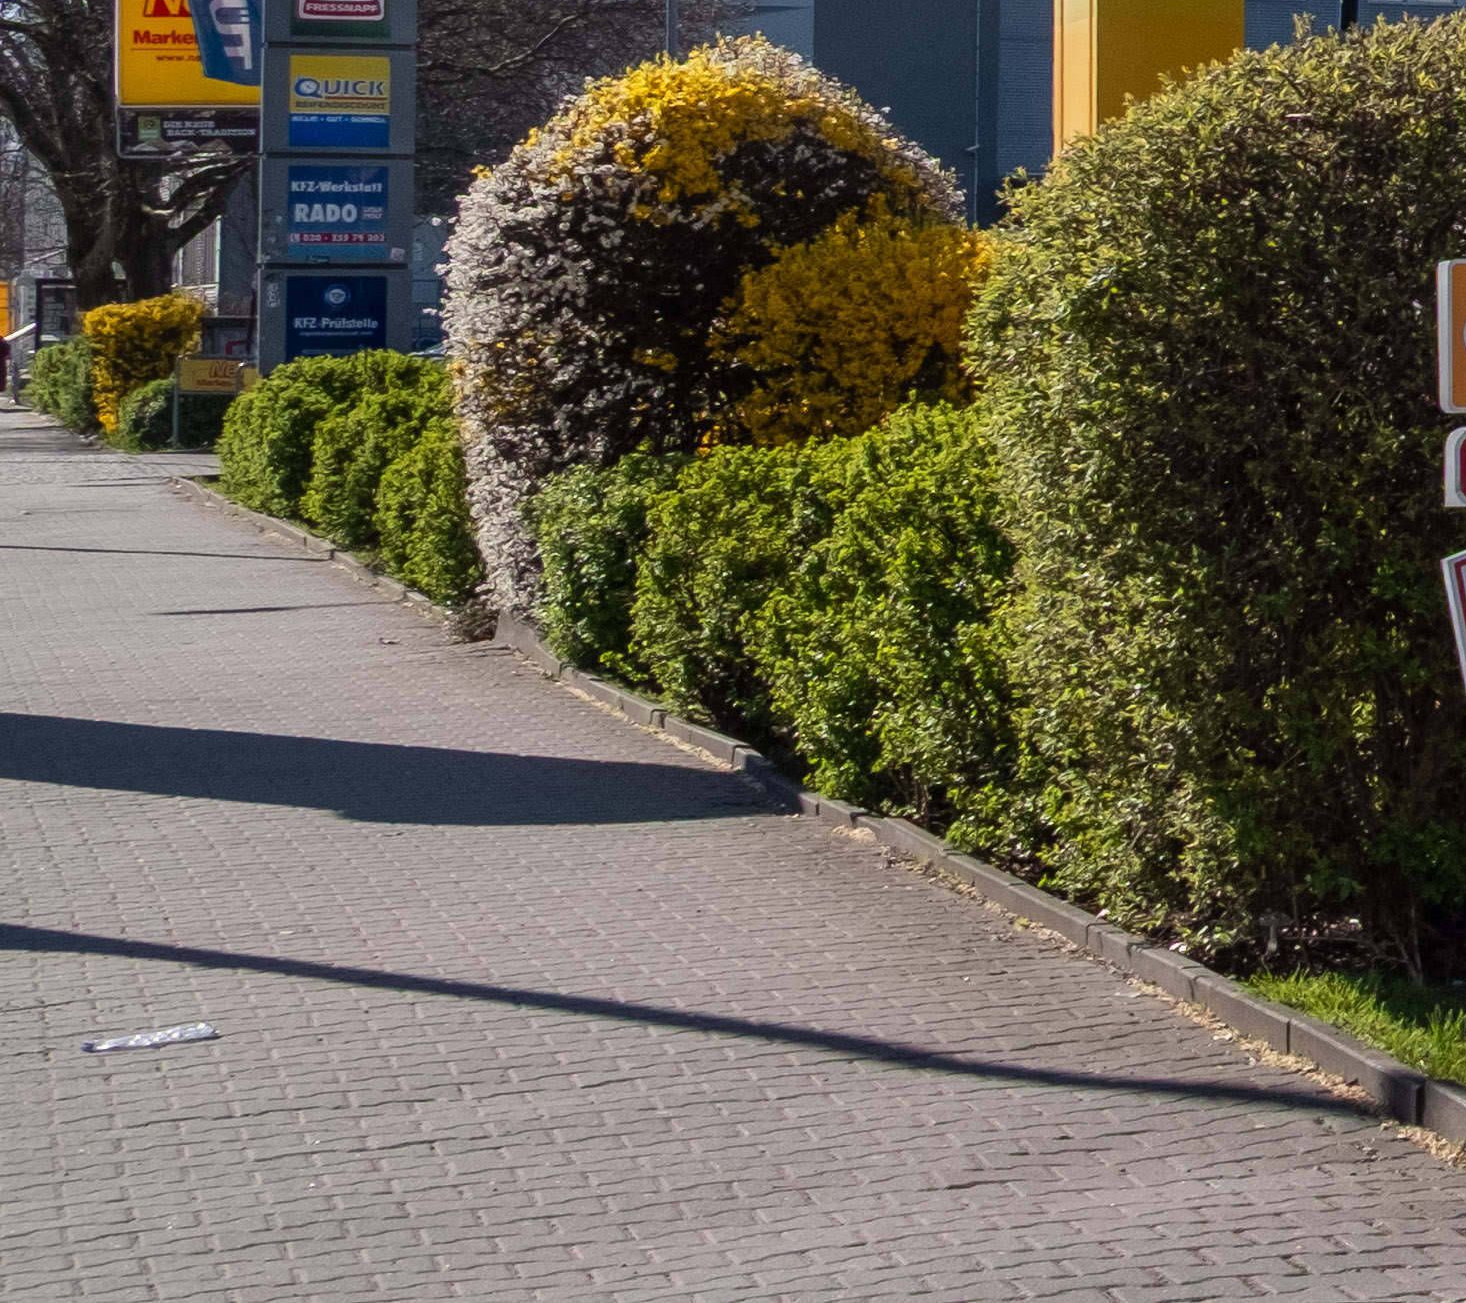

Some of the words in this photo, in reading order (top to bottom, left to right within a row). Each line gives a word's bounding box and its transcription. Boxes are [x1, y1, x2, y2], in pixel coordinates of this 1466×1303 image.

[306, 2, 378, 13] FRESSNAPF
[294, 77, 385, 99] QUICK
[291, 181, 382, 193] KFZ-Werkstatt
[294, 203, 358, 223] RADO
